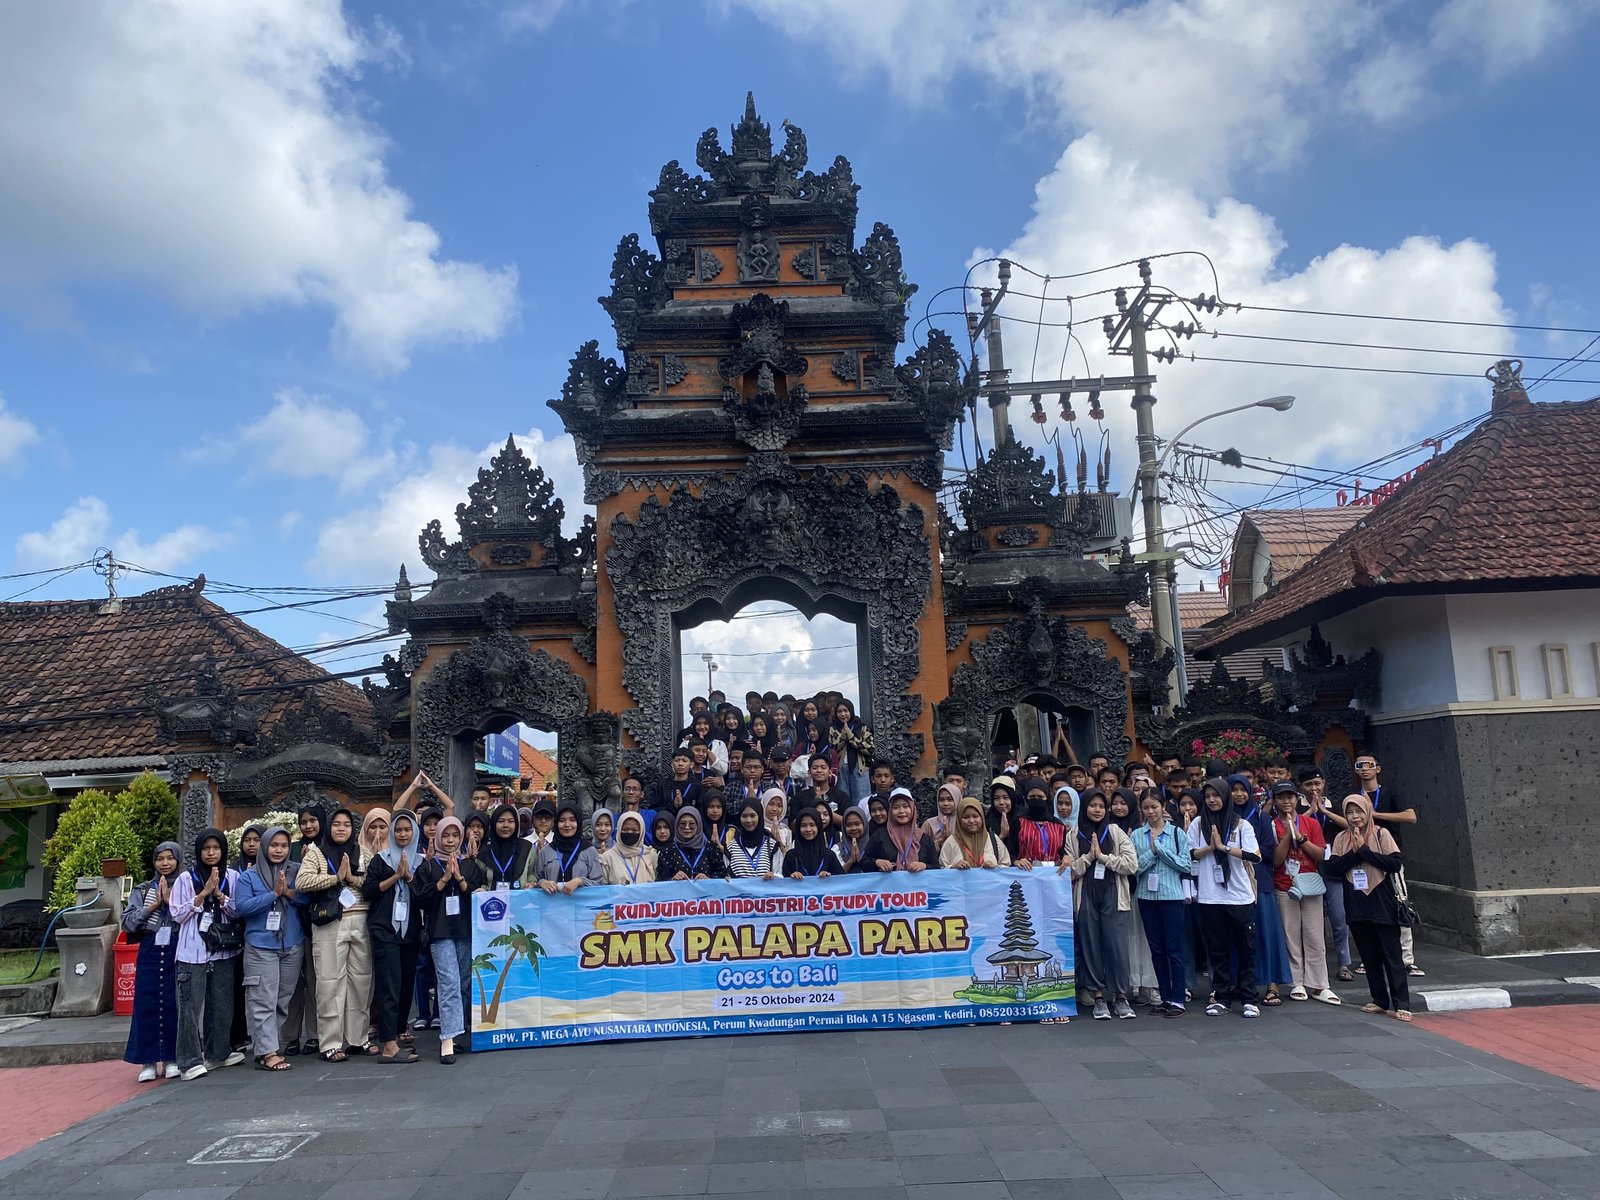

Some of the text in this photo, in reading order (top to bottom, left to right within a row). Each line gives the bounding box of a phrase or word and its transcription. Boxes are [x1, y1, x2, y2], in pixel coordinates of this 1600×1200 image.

[614, 891, 927, 921] KUNJUNGAN INDUSTRI & STUDY TOUR
[580, 915, 970, 969] SMK PALAPA PARE
[717, 963, 839, 989] Goes to Bali
[721, 997, 734, 1007] 21
[745, 996, 758, 1006] 25
[761, 994, 805, 1005] Oktober
[809, 993, 835, 1003] 2024
[492, 1033, 518, 1044] BPW.
[521, 1031, 538, 1042] PT.
[541, 1029, 569, 1040] MEGA
[572, 1027, 591, 1038] AYU
[593, 1023, 651, 1035] NUSANTARA
[654, 1020, 710, 1032] INDONESIA,
[713, 1020, 745, 1030] Perum
[749, 1016, 805, 1028] Kwadungan
[808, 1014, 844, 1026] Permai
[847, 1013, 869, 1024] Blok
[871, 1014, 878, 1023] A
[881, 1013, 894, 1023] 15
[897, 1012, 936, 1024] Ngasem
[944, 1008, 976, 1020] Kediri,
[979, 1003, 1058, 1018] 085203315228
